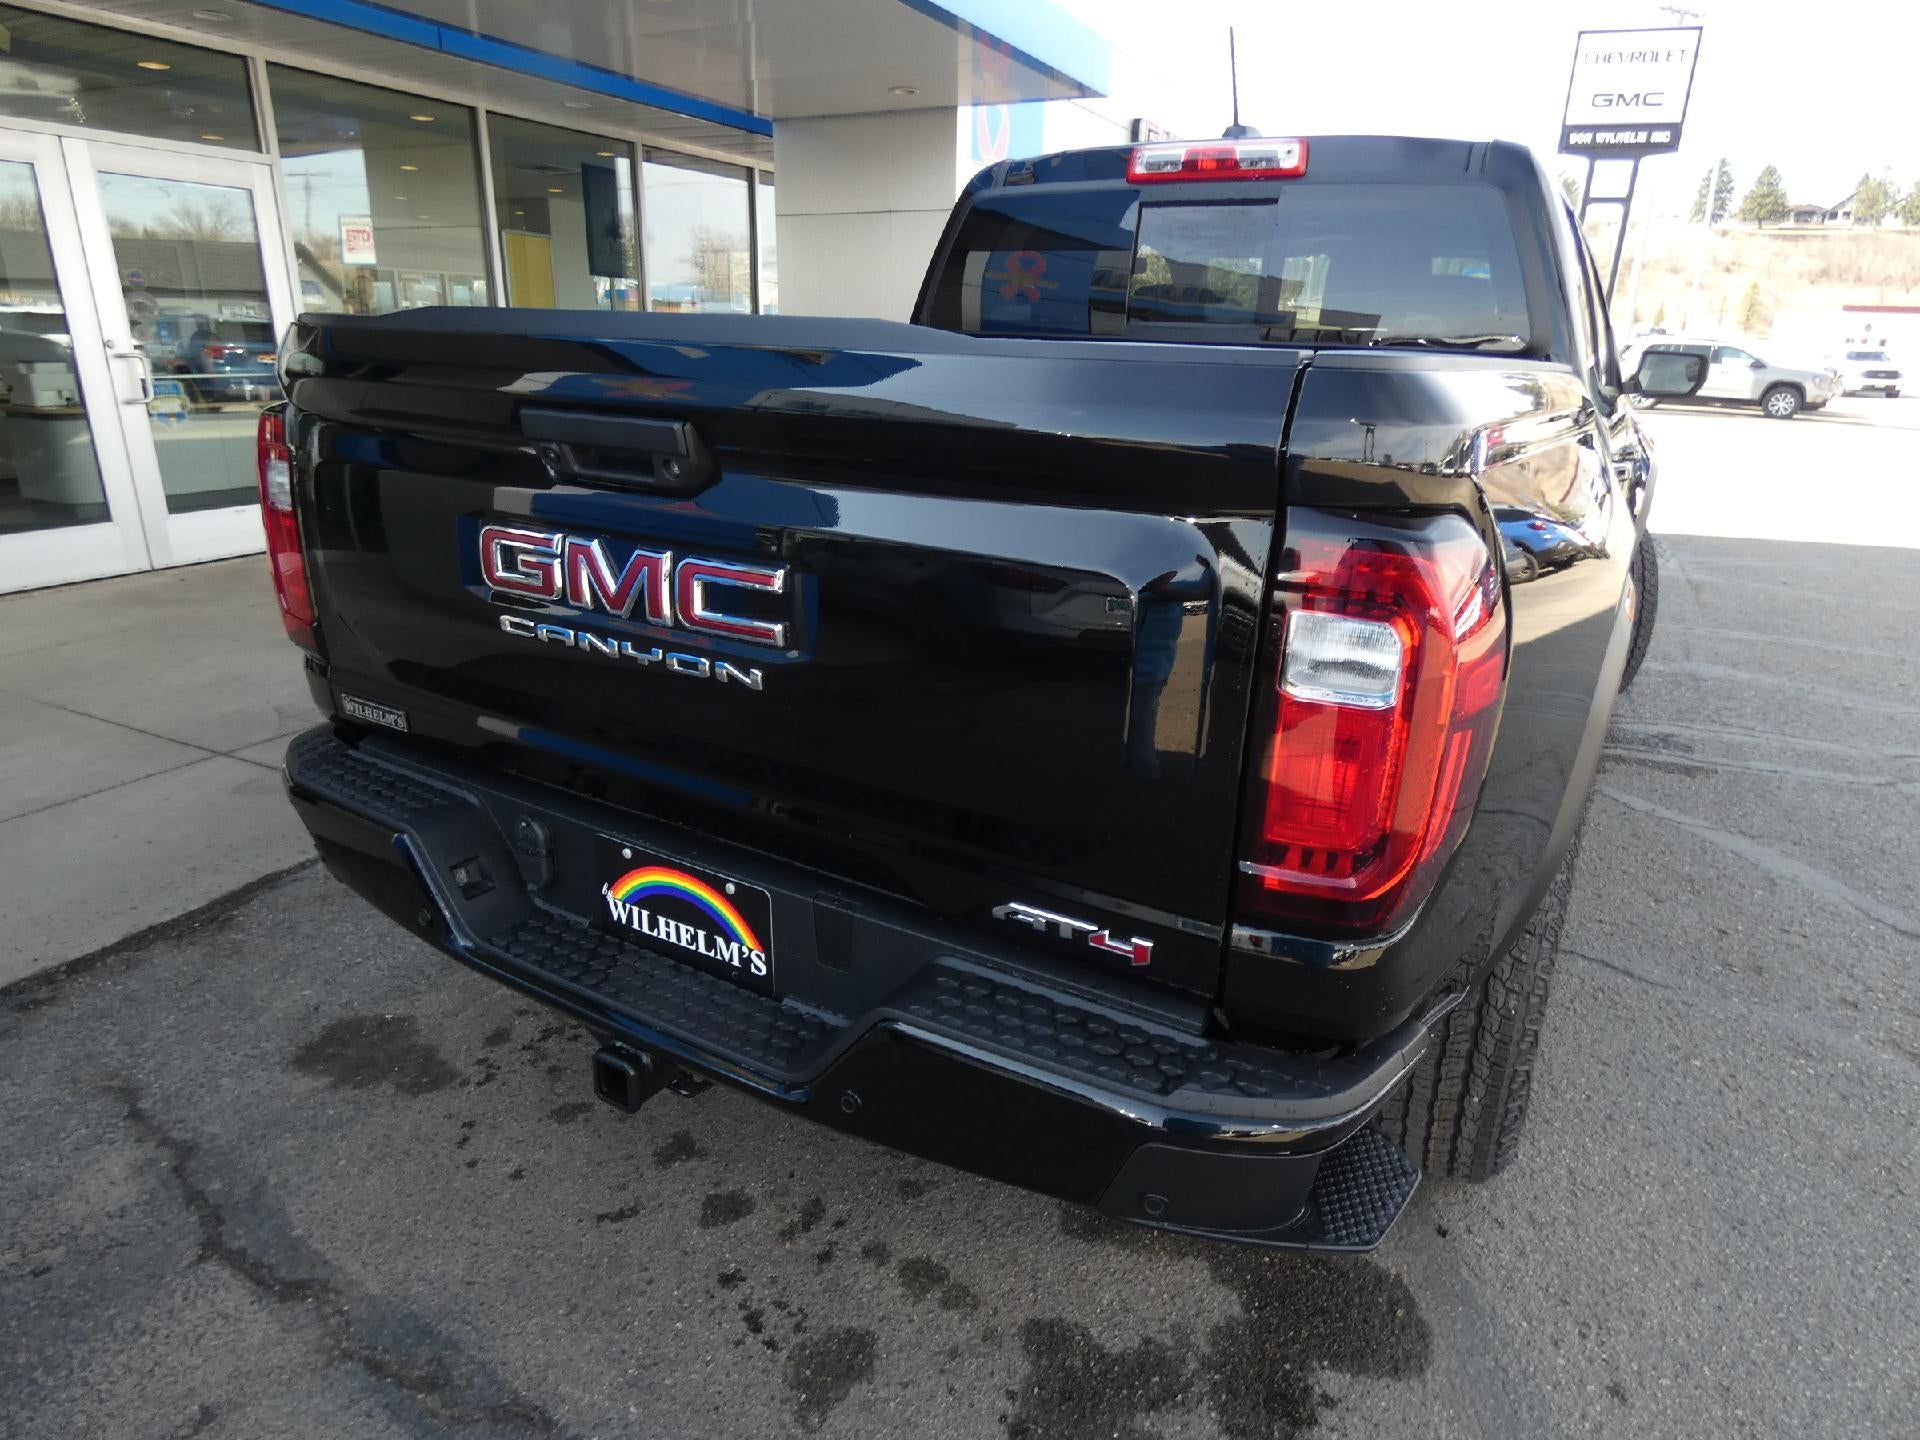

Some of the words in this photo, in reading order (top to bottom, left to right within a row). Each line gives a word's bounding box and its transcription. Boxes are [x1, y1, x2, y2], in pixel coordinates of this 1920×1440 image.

[1591, 92, 1664, 107] GMC
[480, 525, 789, 647] GMC
[499, 614, 763, 691] CANYON
[607, 898, 767, 976] WILHELM'S
[991, 902, 1153, 966] AT4
